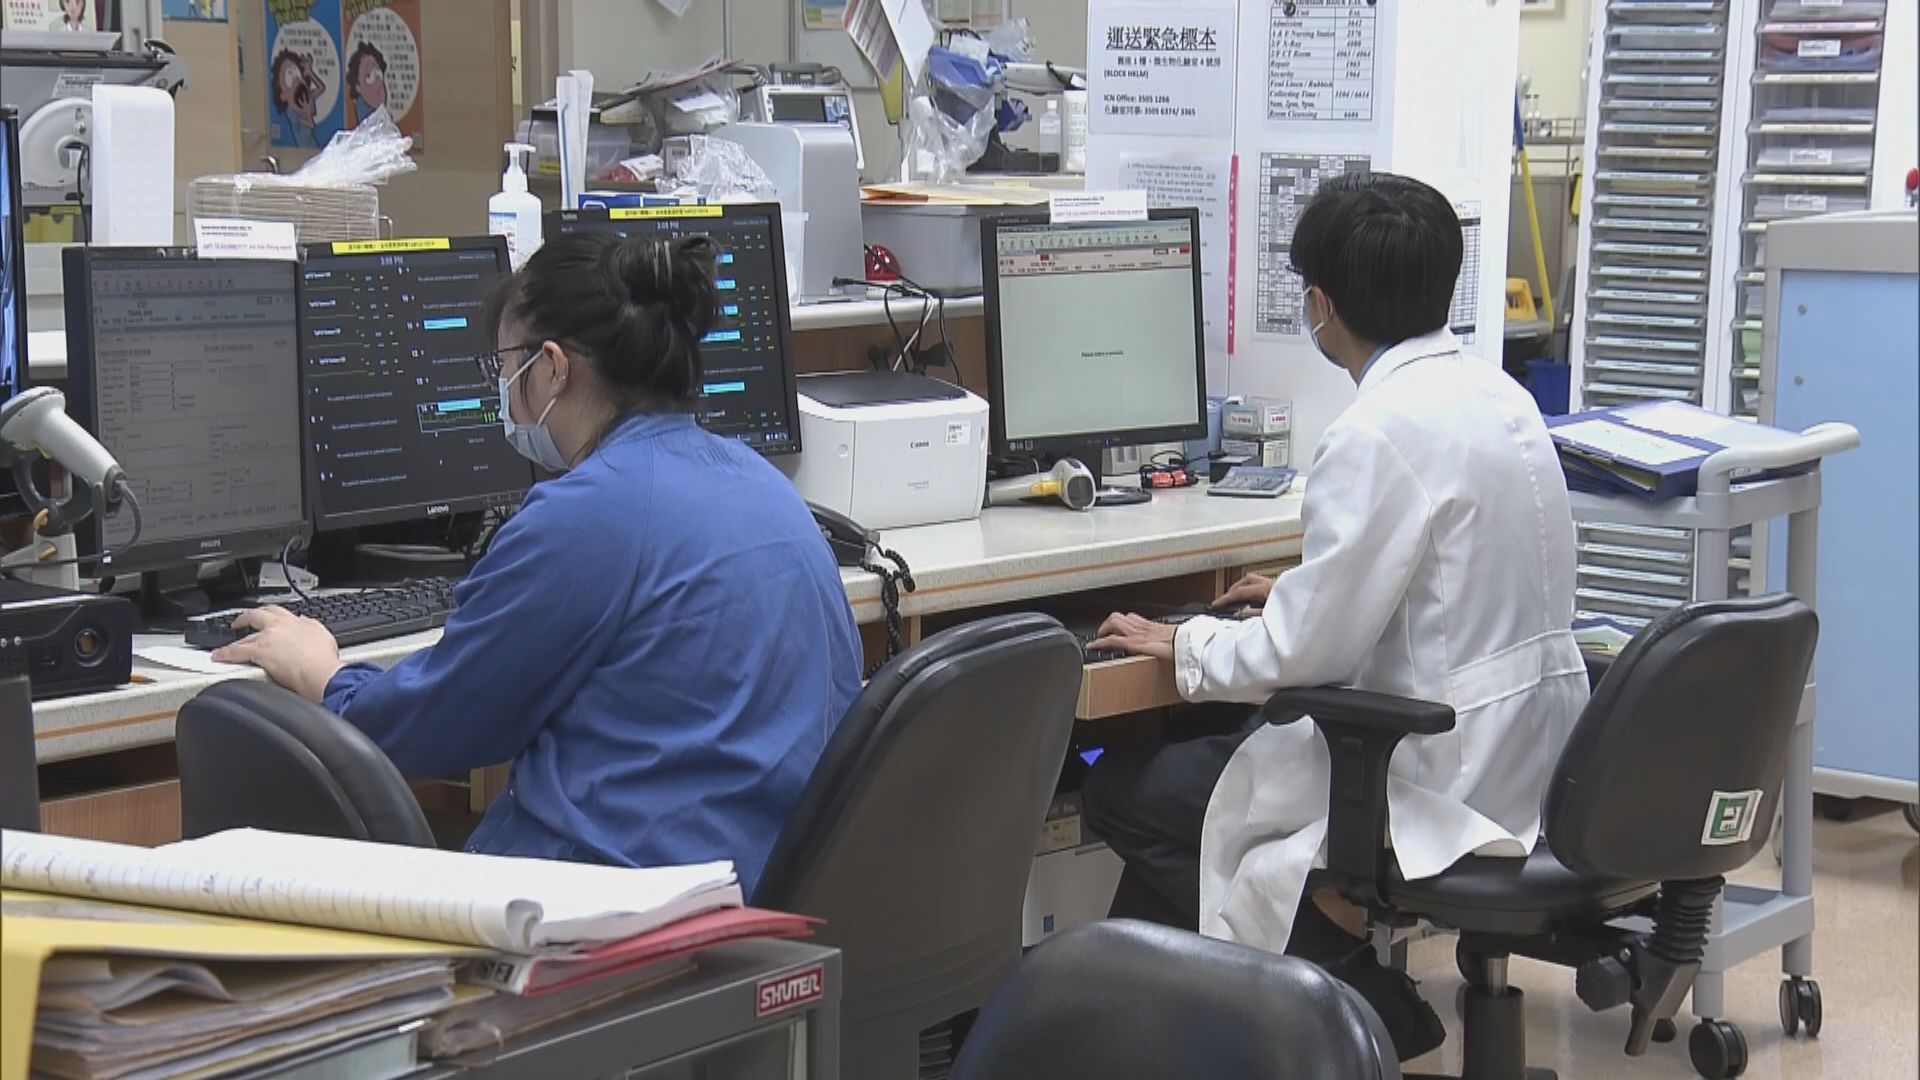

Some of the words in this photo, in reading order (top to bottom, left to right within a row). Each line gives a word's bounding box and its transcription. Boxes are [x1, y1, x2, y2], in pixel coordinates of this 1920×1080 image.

[1273, 19, 1303, 27] Admission
[1106, 25, 1217, 51] 運送緊急標本
[1289, 30, 1315, 39] Nursing
[1270, 60, 1290, 69] Repair
[1103, 69, 1127, 79] (BLOCK
[1270, 70, 1294, 79] Security
[1308, 80, 1333, 88] Rubbish
[1103, 94, 1115, 102] ICN
[1116, 94, 1137, 103] Office:
[1269, 90, 1300, 99] Collecting
[1301, 90, 1316, 98] Time
[910, 440, 930, 449] Canon
[426, 504, 450, 516] Lenovo
[760, 974, 821, 1010] SHUTER
